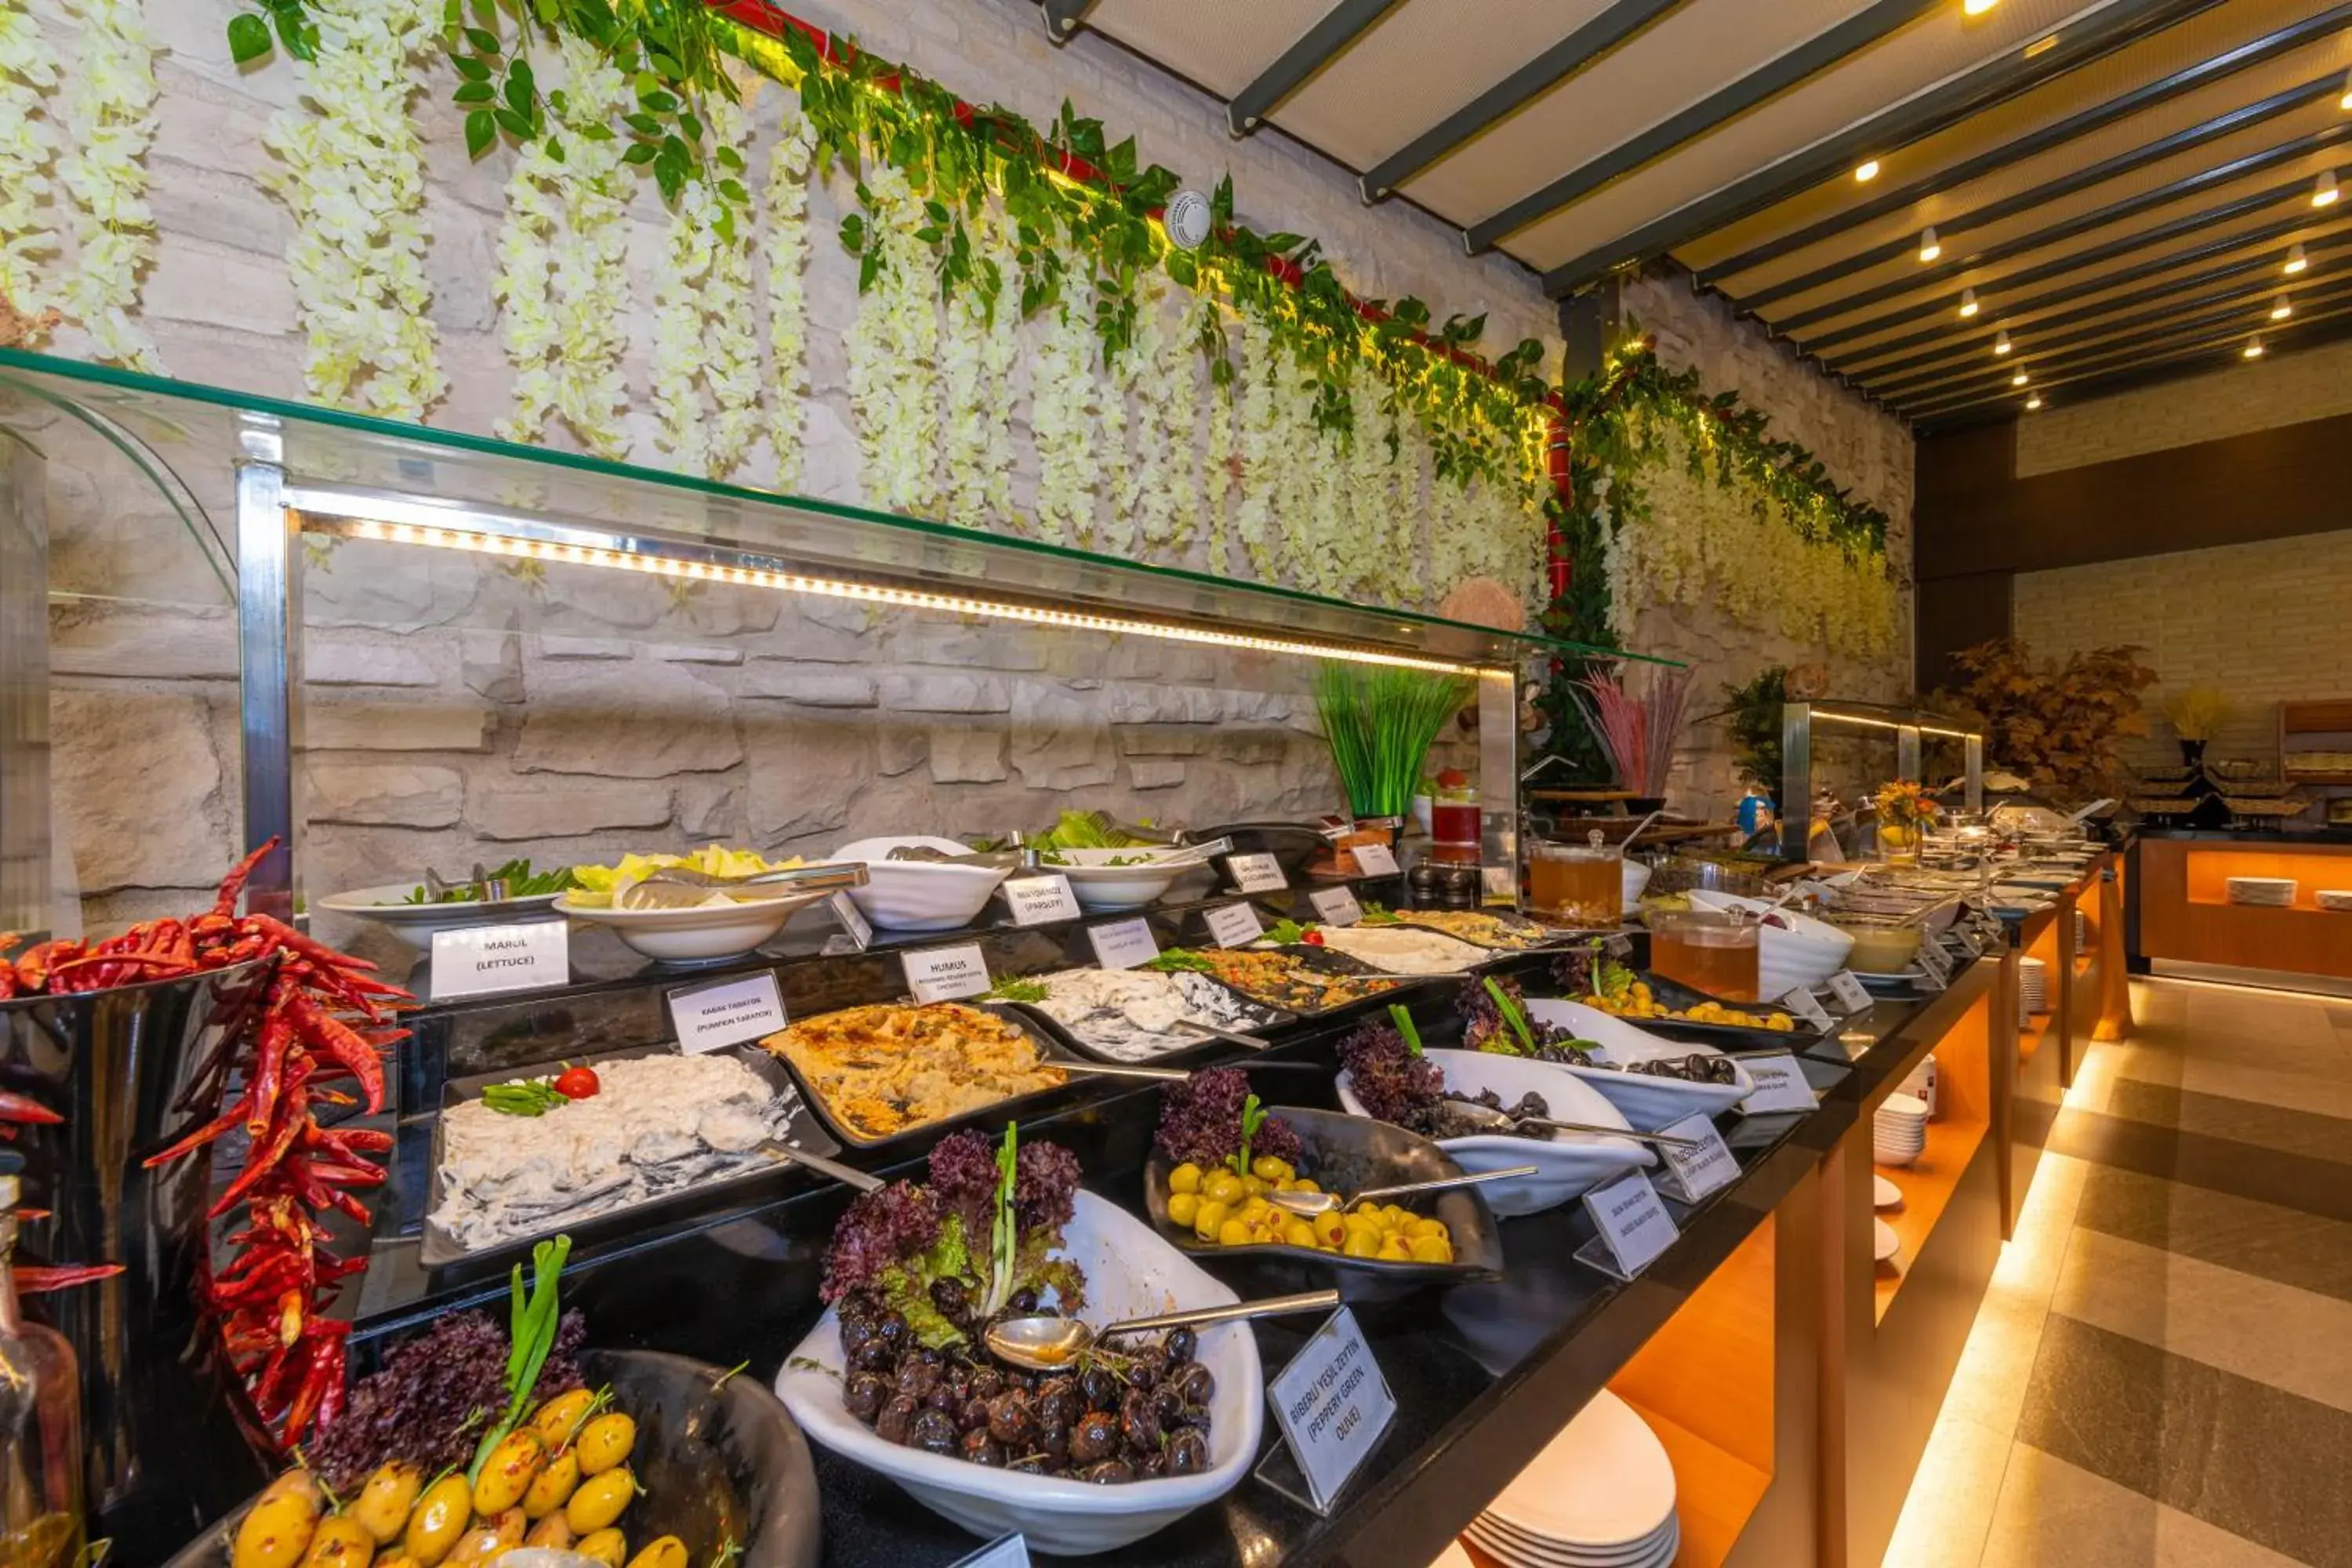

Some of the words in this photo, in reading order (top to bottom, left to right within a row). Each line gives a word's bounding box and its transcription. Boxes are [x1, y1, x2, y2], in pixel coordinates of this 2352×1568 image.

[484, 939, 528, 950] MARUL
[477, 956, 535, 971] (LETTUCE)
[931, 960, 967, 972] HUMUS
[1307, 1392, 1343, 1443] (PEPPERY
[1340, 1364, 1365, 1399] GREEN
[1335, 1405, 1362, 1441] OLIVE)
